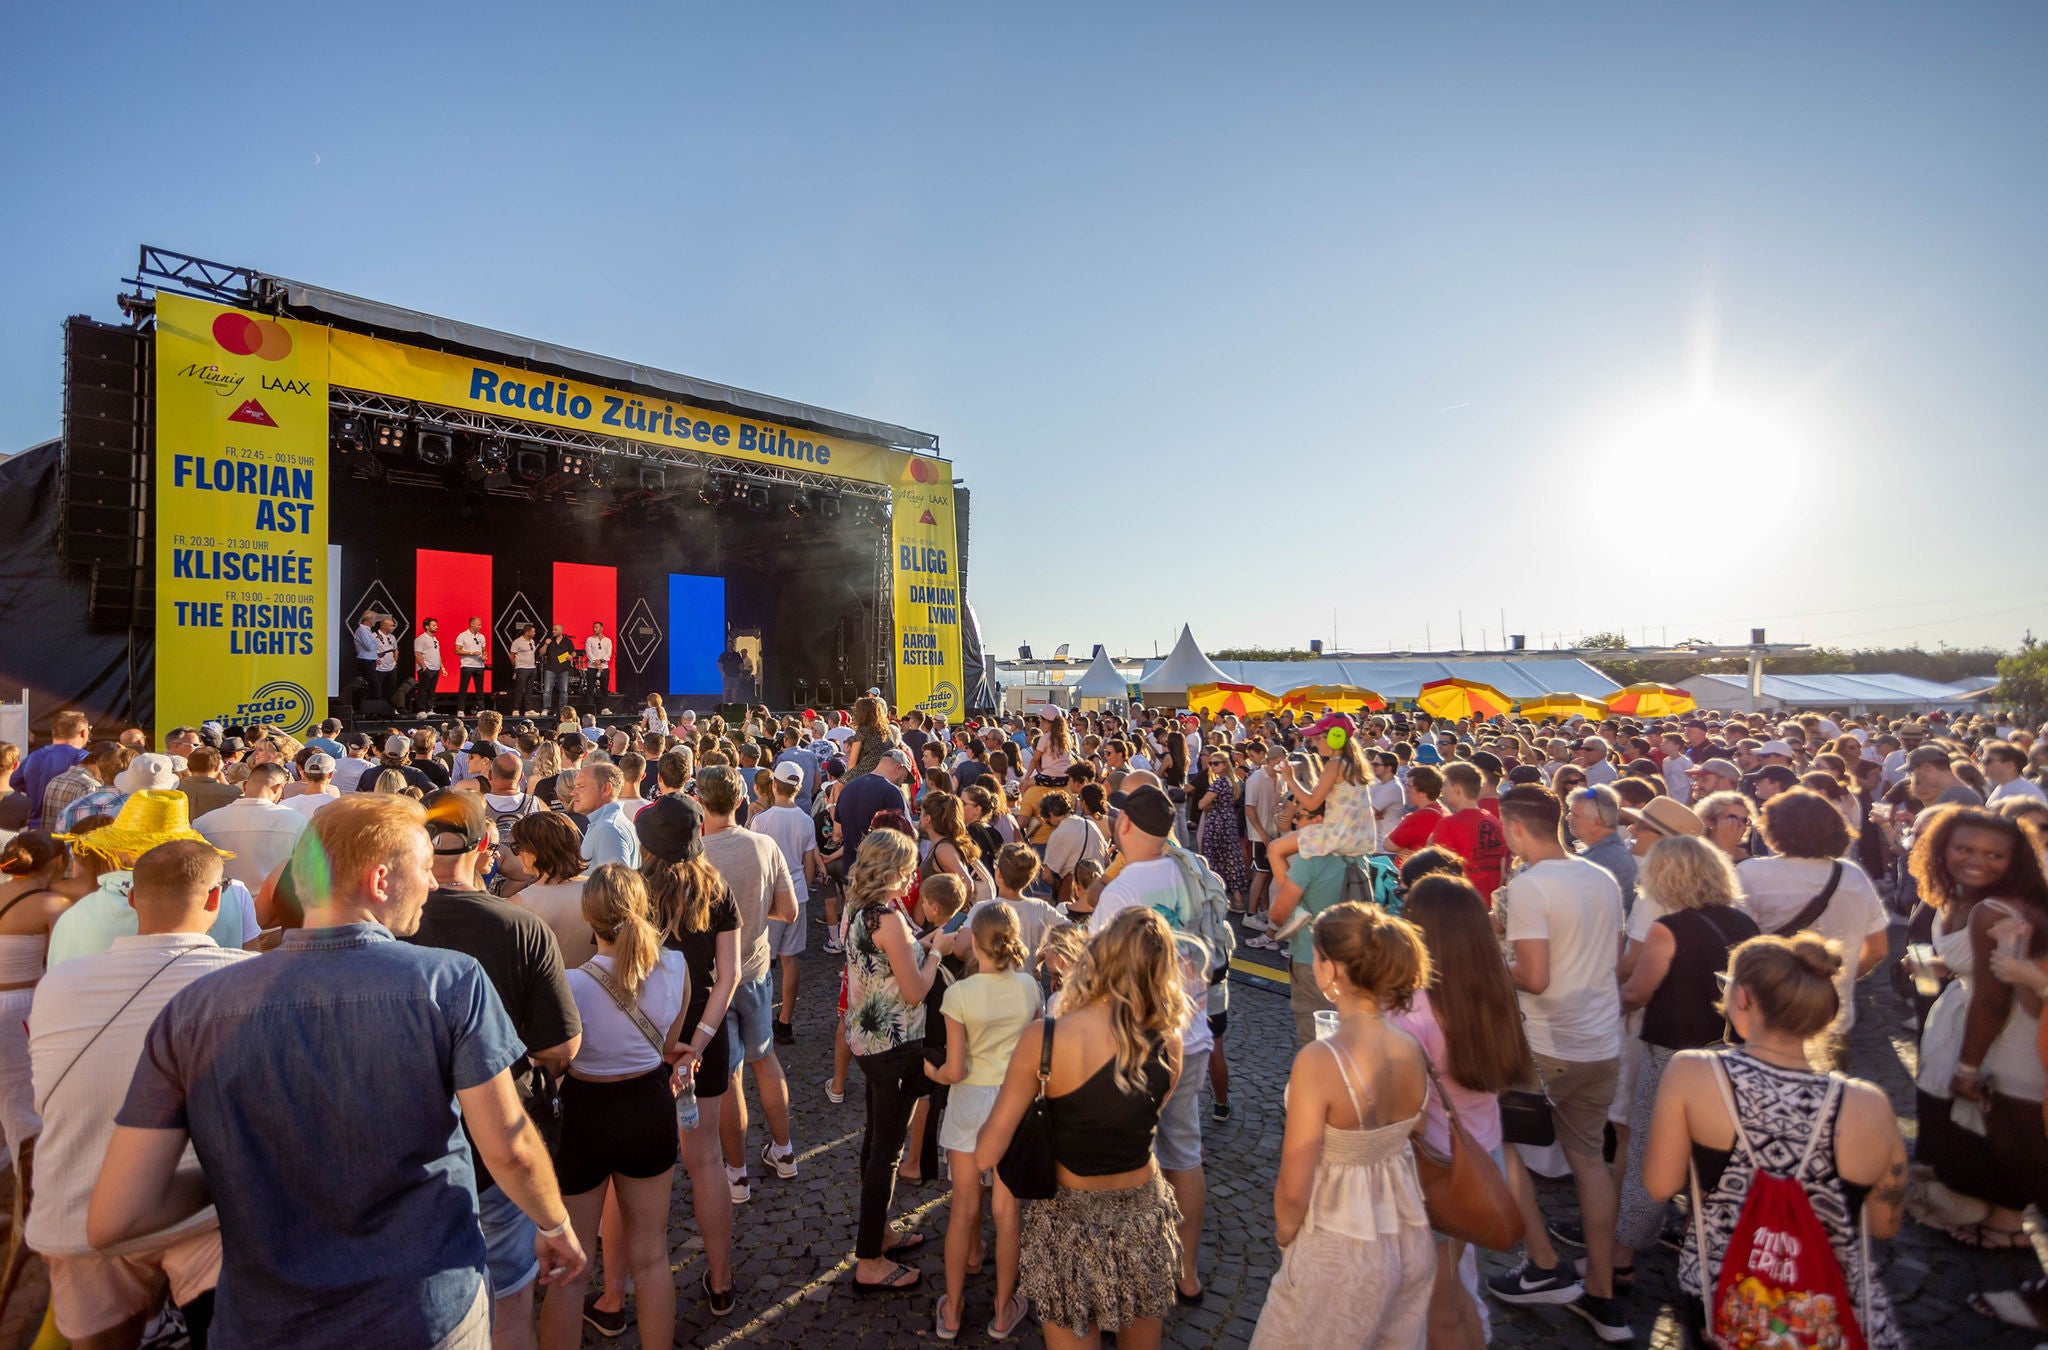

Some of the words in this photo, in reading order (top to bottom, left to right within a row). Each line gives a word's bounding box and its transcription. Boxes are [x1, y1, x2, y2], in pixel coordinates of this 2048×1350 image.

[178, 364, 245, 397] Minnig
[261, 375, 312, 396] LAAX
[468, 367, 593, 420] Radio
[601, 395, 731, 447] Zürisee
[737, 424, 831, 465] Bühne
[275, 452, 296, 464] 00.15
[298, 455, 314, 466] UHR
[173, 453, 313, 500] FLORIAN
[929, 494, 949, 506] LAAX
[255, 498, 315, 535] AST
[190, 535, 215, 547] 20.30
[252, 540, 269, 551] UHR
[173, 548, 313, 585] KLISCHÉE
[900, 544, 947, 574] BLIGG
[241, 591, 263, 602] 19.00
[273, 593, 296, 604] 20.00
[298, 594, 314, 605] UHR
[909, 585, 956, 606] DAMIAN
[174, 601, 224, 627] THE
[232, 603, 313, 630] RISING
[928, 605, 957, 625] LYNN
[229, 630, 314, 655] LIGHTS
[902, 633, 937, 649] AARON
[902, 649, 945, 666] ASTERIA
[236, 697, 297, 714] radio
[927, 691, 952, 701] radio
